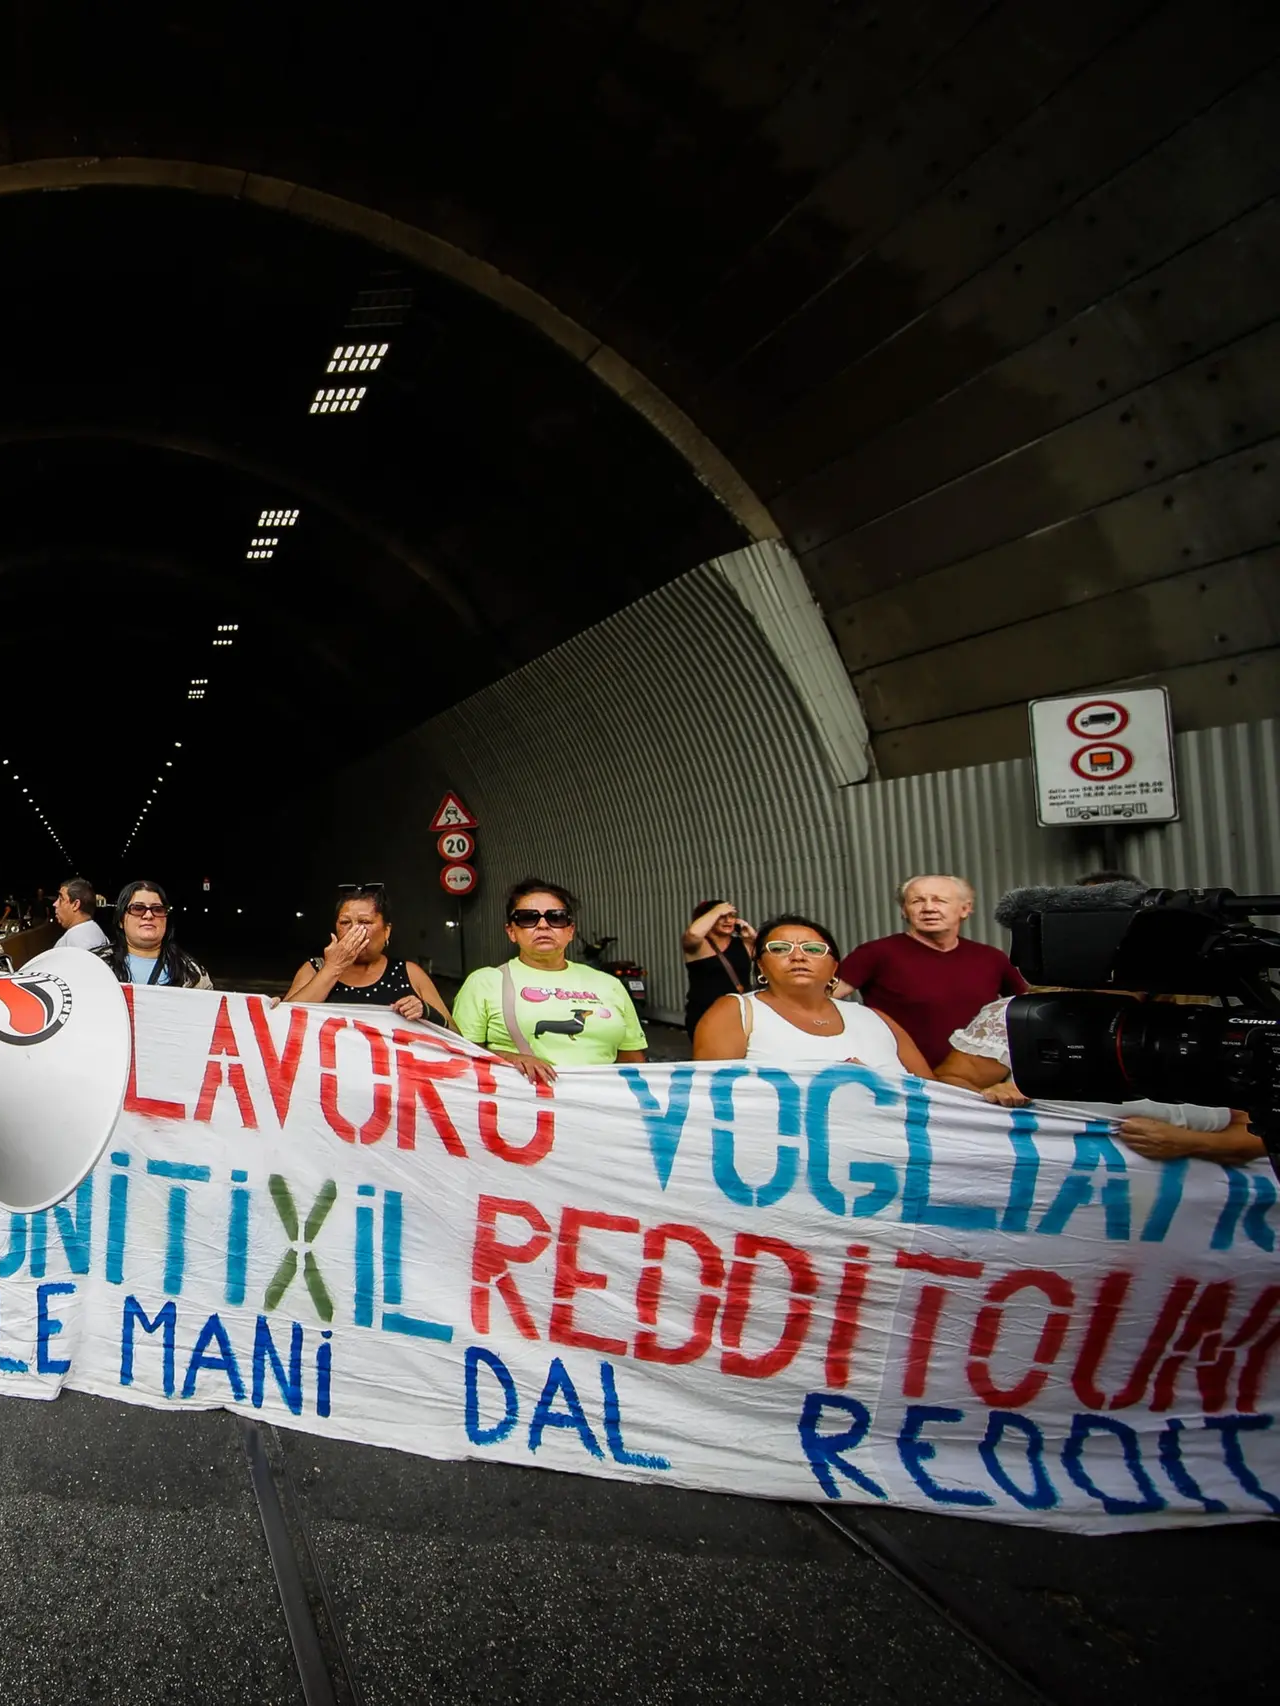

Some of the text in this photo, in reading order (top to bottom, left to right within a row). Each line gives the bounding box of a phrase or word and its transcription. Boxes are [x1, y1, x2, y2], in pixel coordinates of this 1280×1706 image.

[445, 837, 467, 854] 20
[1228, 1017, 1277, 1026] Canon
[122, 984, 556, 1167] LAVORO
[463, 1347, 672, 1471] DAL
